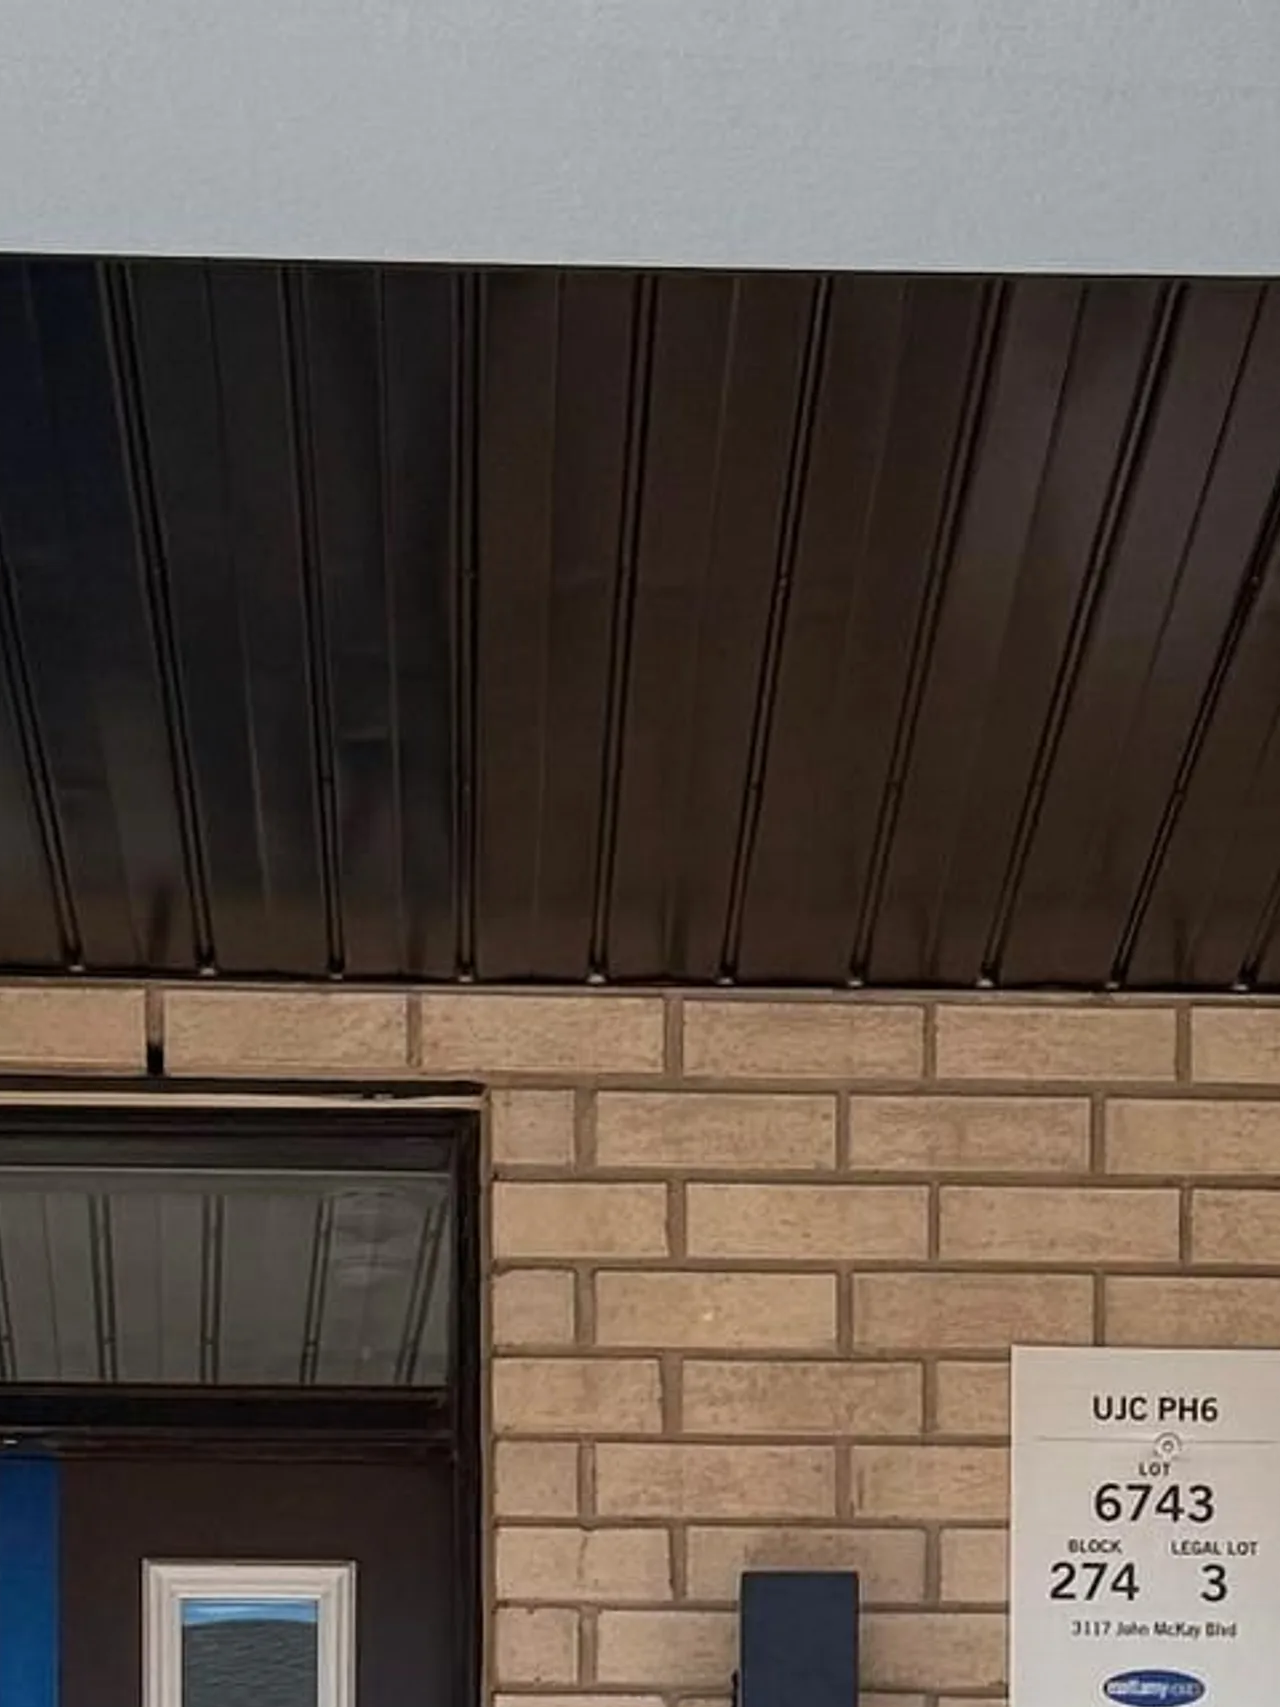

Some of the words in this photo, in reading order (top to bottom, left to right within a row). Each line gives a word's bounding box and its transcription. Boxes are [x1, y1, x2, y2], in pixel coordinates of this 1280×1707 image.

[1092, 1395, 1148, 1422] UJC
[1157, 1397, 1219, 1423] PH6
[1138, 1461, 1172, 1477] LOT
[1094, 1482, 1215, 1524] 6743
[1068, 1538, 1123, 1555] BLOCK
[1171, 1540, 1222, 1556] LEGAL
[1226, 1541, 1259, 1556] LOT
[1050, 1560, 1141, 1601] 274
[1200, 1563, 1228, 1603] 3
[1071, 1620, 1112, 1637] 3117
[1116, 1620, 1150, 1637] John
[1153, 1620, 1202, 1640] McKay
[1205, 1621, 1238, 1639] Blvd
